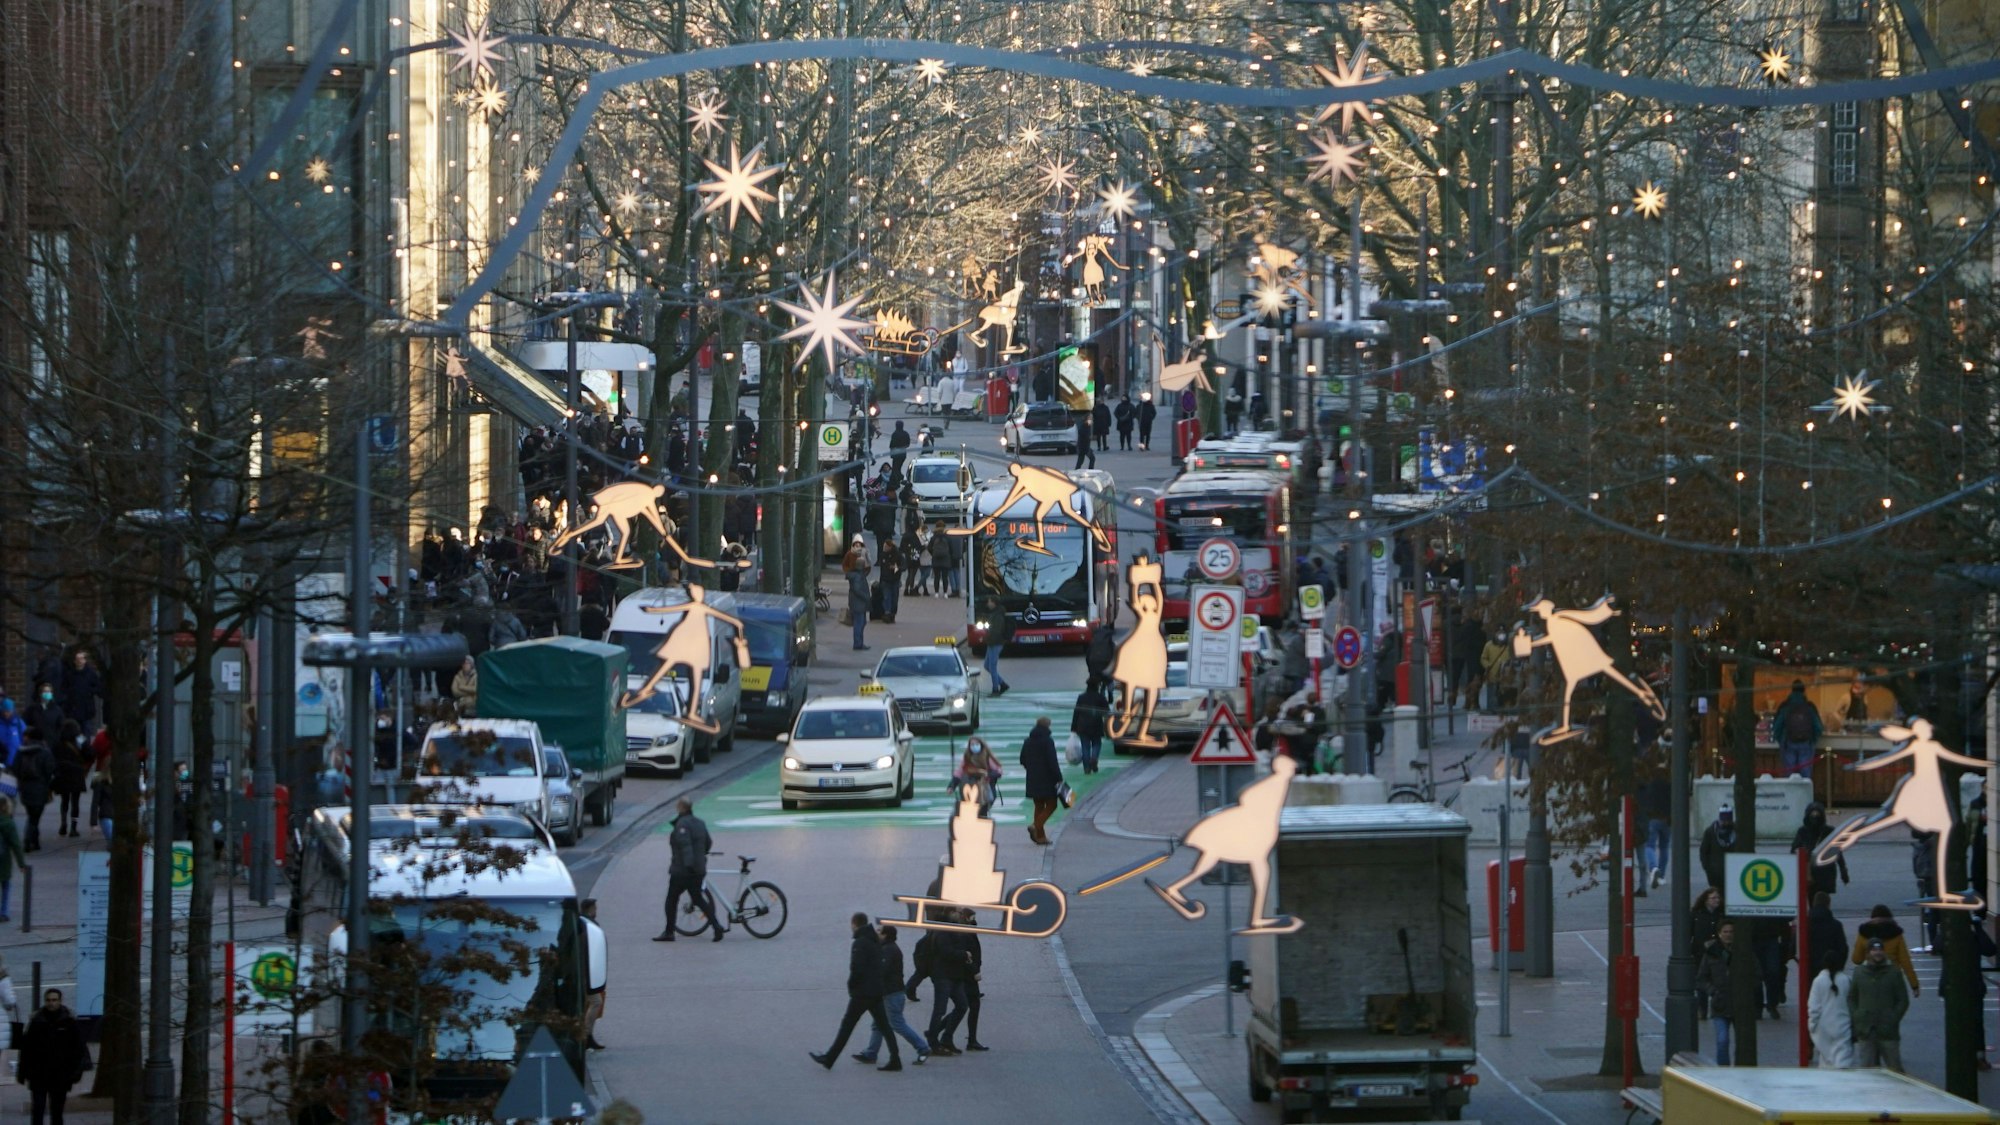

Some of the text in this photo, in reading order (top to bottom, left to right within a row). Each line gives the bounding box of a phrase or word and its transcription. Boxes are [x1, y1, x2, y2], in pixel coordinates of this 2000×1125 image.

[828, 431, 837, 441] H
[986, 522, 1067, 535] 19 U Alsrdorf
[1208, 549, 1231, 567] 25
[1752, 869, 1771, 892] H
[264, 963, 284, 987] H
